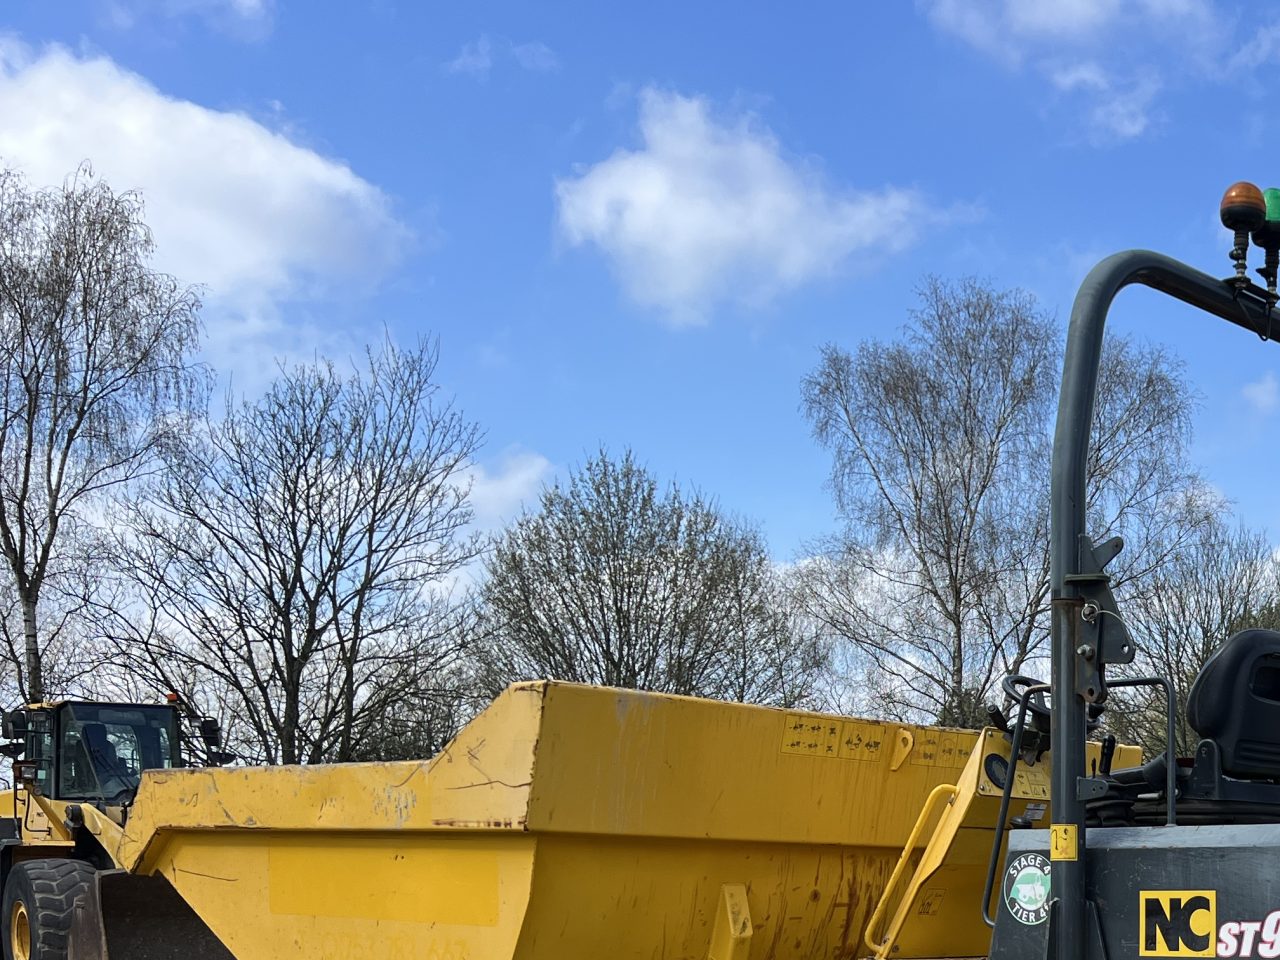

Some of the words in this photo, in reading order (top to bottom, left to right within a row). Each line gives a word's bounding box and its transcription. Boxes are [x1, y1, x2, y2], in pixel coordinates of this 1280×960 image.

[1010, 855, 1042, 877] STAGE
[1043, 865, 1051, 875] 4
[1012, 902, 1036, 922] TIER
[1145, 896, 1211, 952] NC
